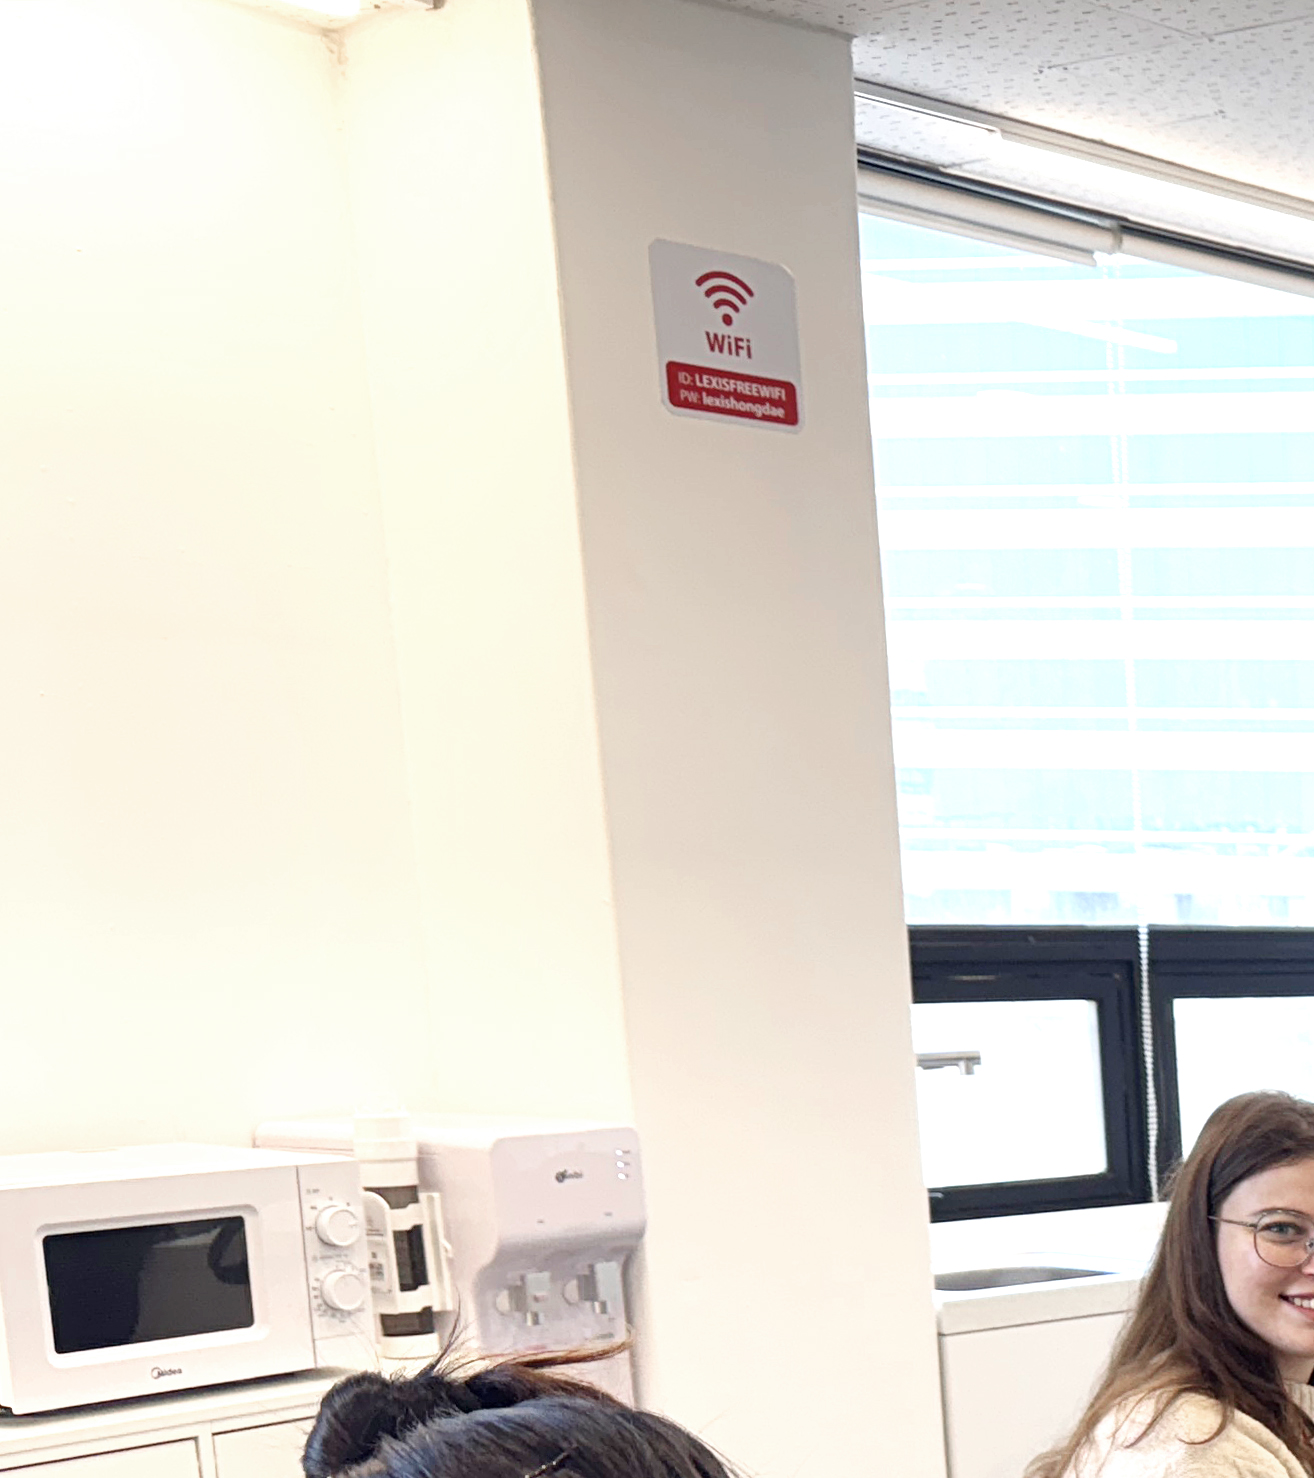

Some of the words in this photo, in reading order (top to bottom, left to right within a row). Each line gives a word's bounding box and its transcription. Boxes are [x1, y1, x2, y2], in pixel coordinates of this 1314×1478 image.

[705, 331, 753, 359] WiFi
[678, 371, 693, 386] ID:
[695, 373, 786, 401] LEXISFREEWIFI
[680, 389, 700, 404] PW:
[702, 392, 785, 418] lexishongdae
